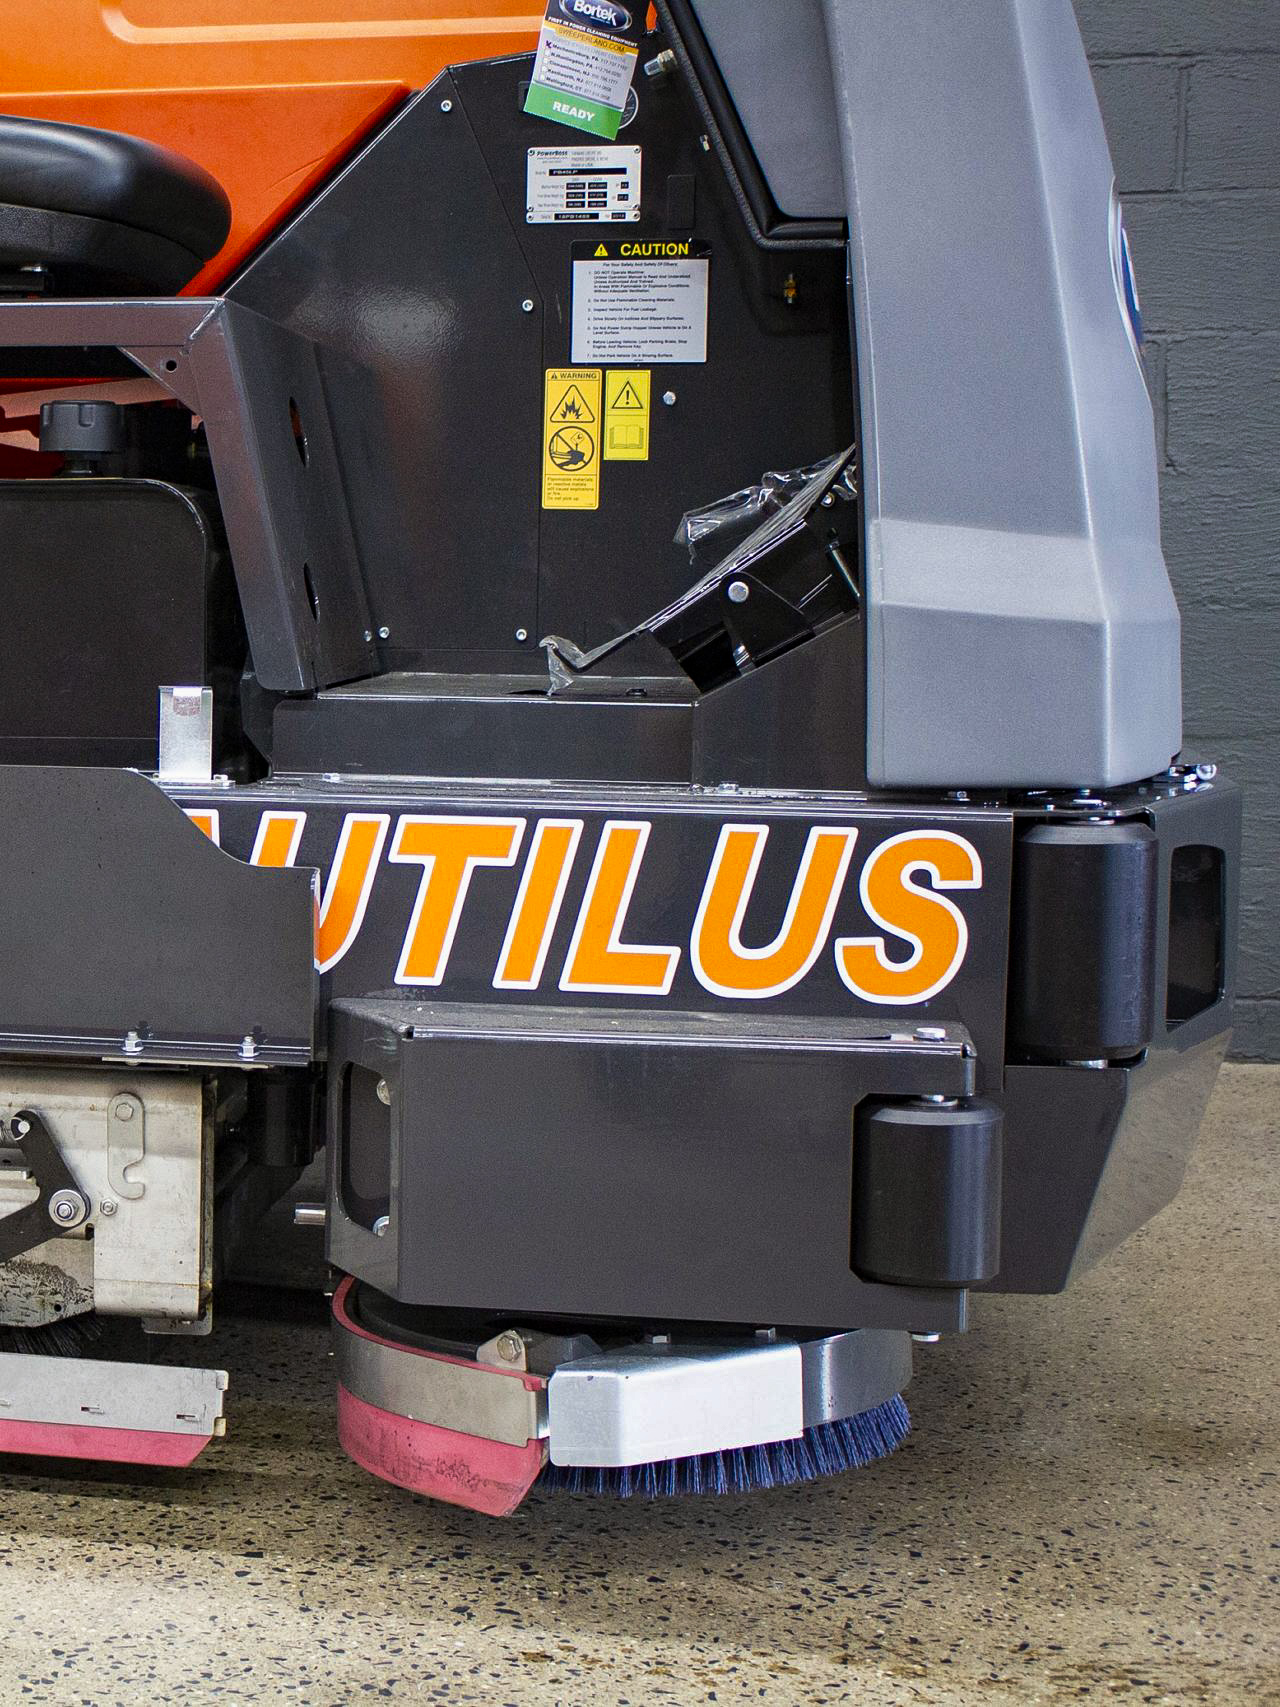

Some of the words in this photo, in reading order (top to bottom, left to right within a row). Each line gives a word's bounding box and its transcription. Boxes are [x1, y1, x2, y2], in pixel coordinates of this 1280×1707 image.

[573, 0, 617, 26] Bortek
[552, 101, 596, 122] READY
[620, 242, 689, 256] CAUTION
[181, 808, 983, 1005] UTILUS
